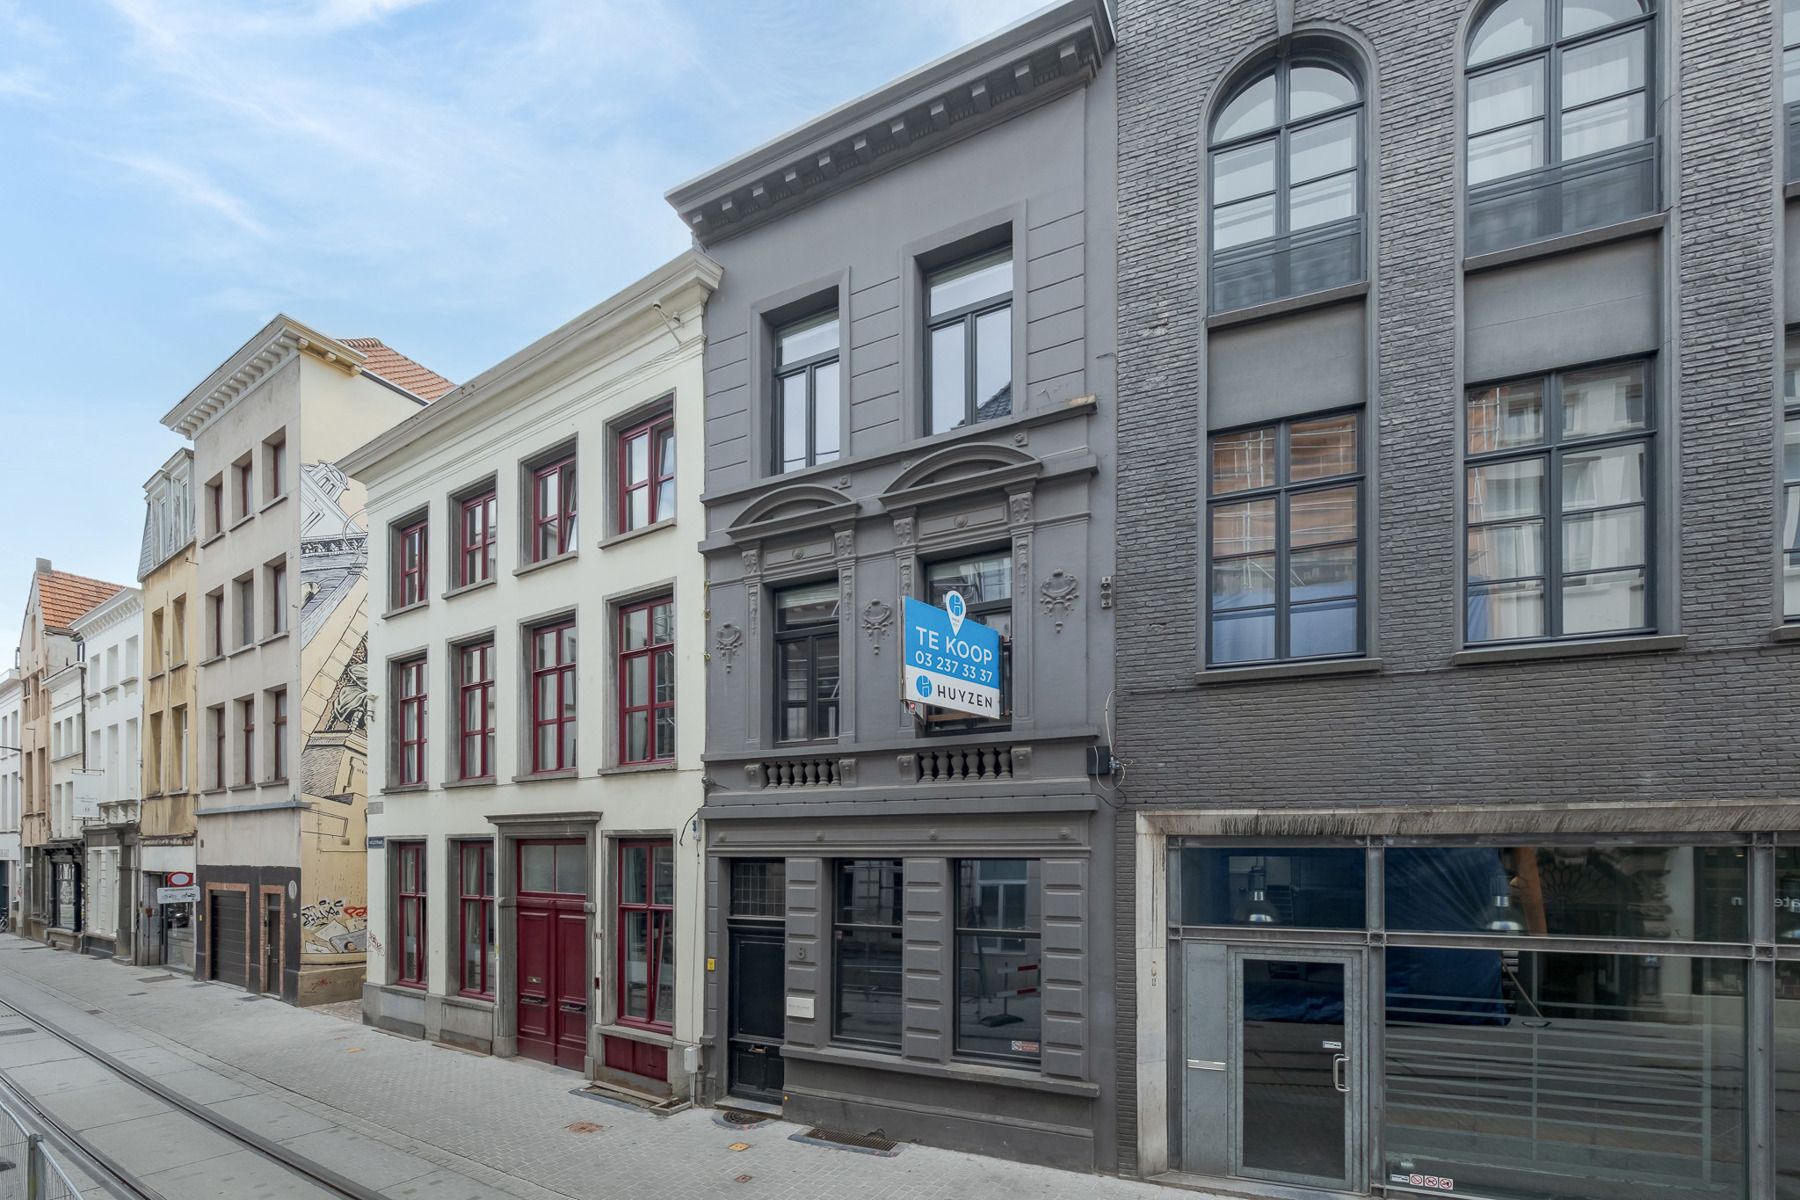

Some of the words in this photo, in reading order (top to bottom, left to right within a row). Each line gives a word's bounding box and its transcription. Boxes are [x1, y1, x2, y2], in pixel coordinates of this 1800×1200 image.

[915, 625, 940, 651] TE
[945, 635, 993, 665] KOOP
[915, 650, 933, 667] 03
[936, 656, 959, 674] 237
[962, 663, 977, 679] 33
[979, 668, 993, 683] 37
[937, 684, 993, 709] HUYZEN
